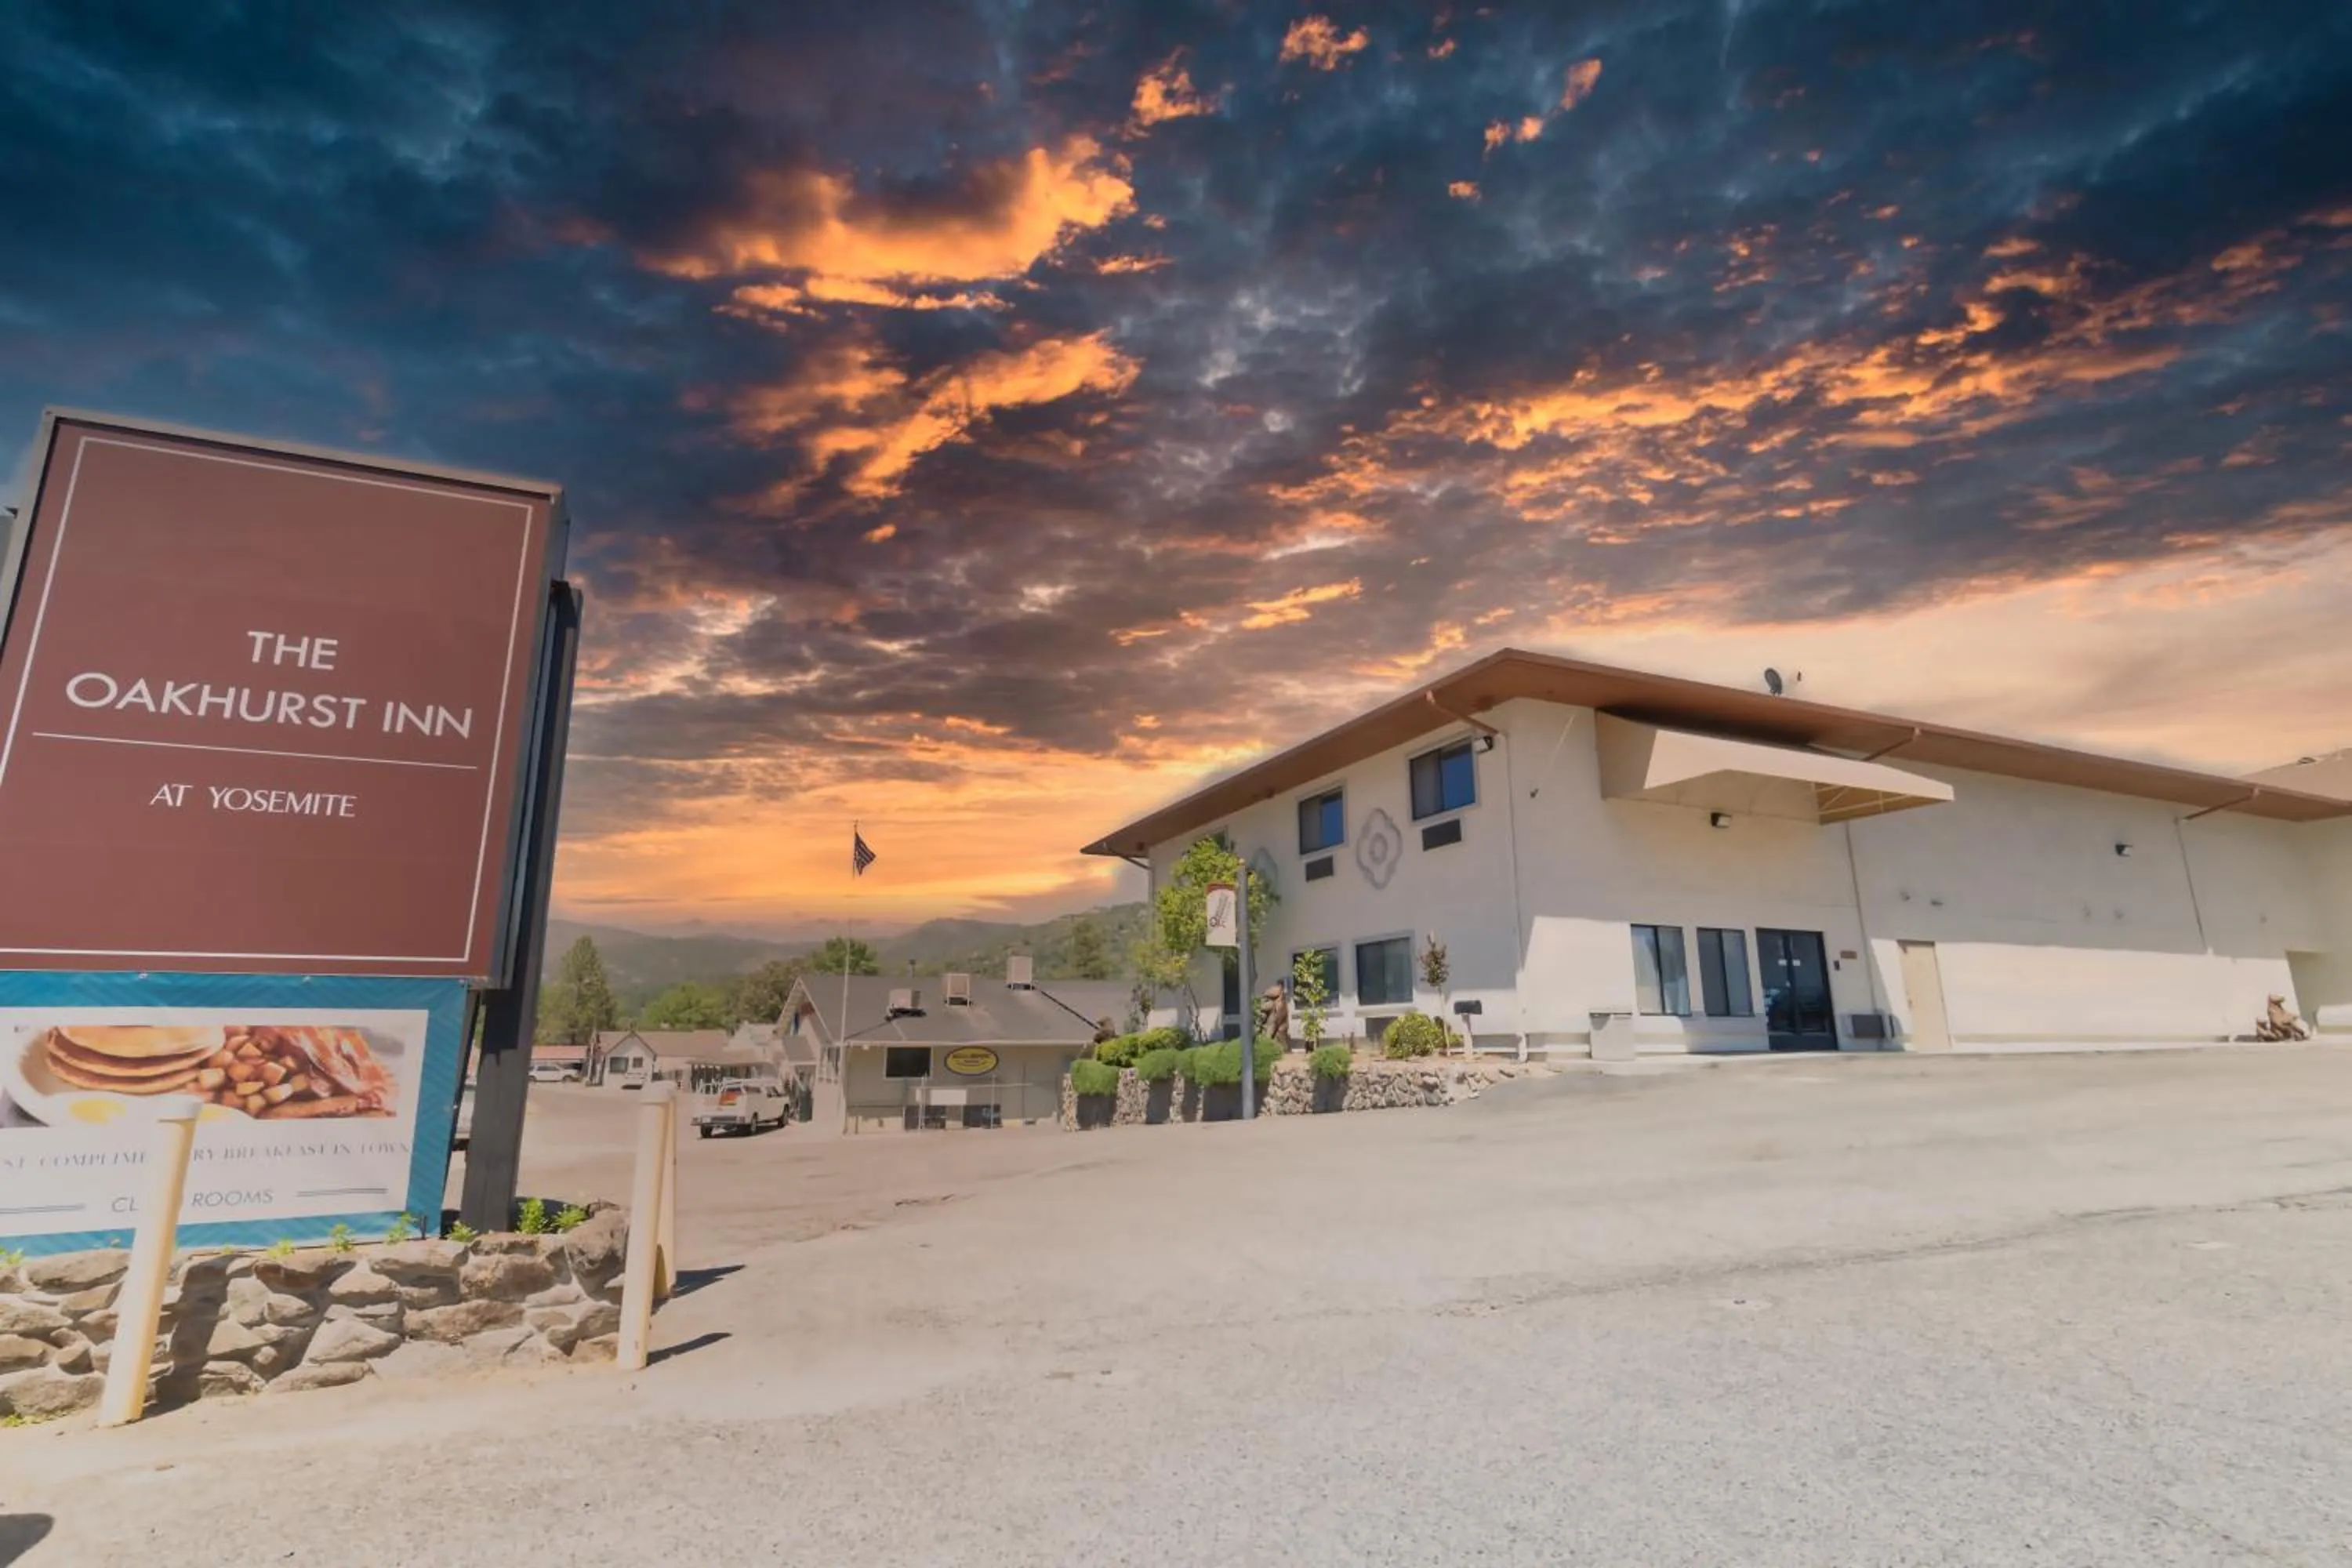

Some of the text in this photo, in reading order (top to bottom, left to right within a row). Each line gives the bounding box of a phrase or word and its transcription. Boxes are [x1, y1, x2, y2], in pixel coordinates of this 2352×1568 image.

[247, 630, 338, 670] THE
[66, 673, 472, 740] OAKHURST INN
[149, 783, 358, 818] AT YOSEMITE
[192, 1189, 274, 1207] ROOMS
